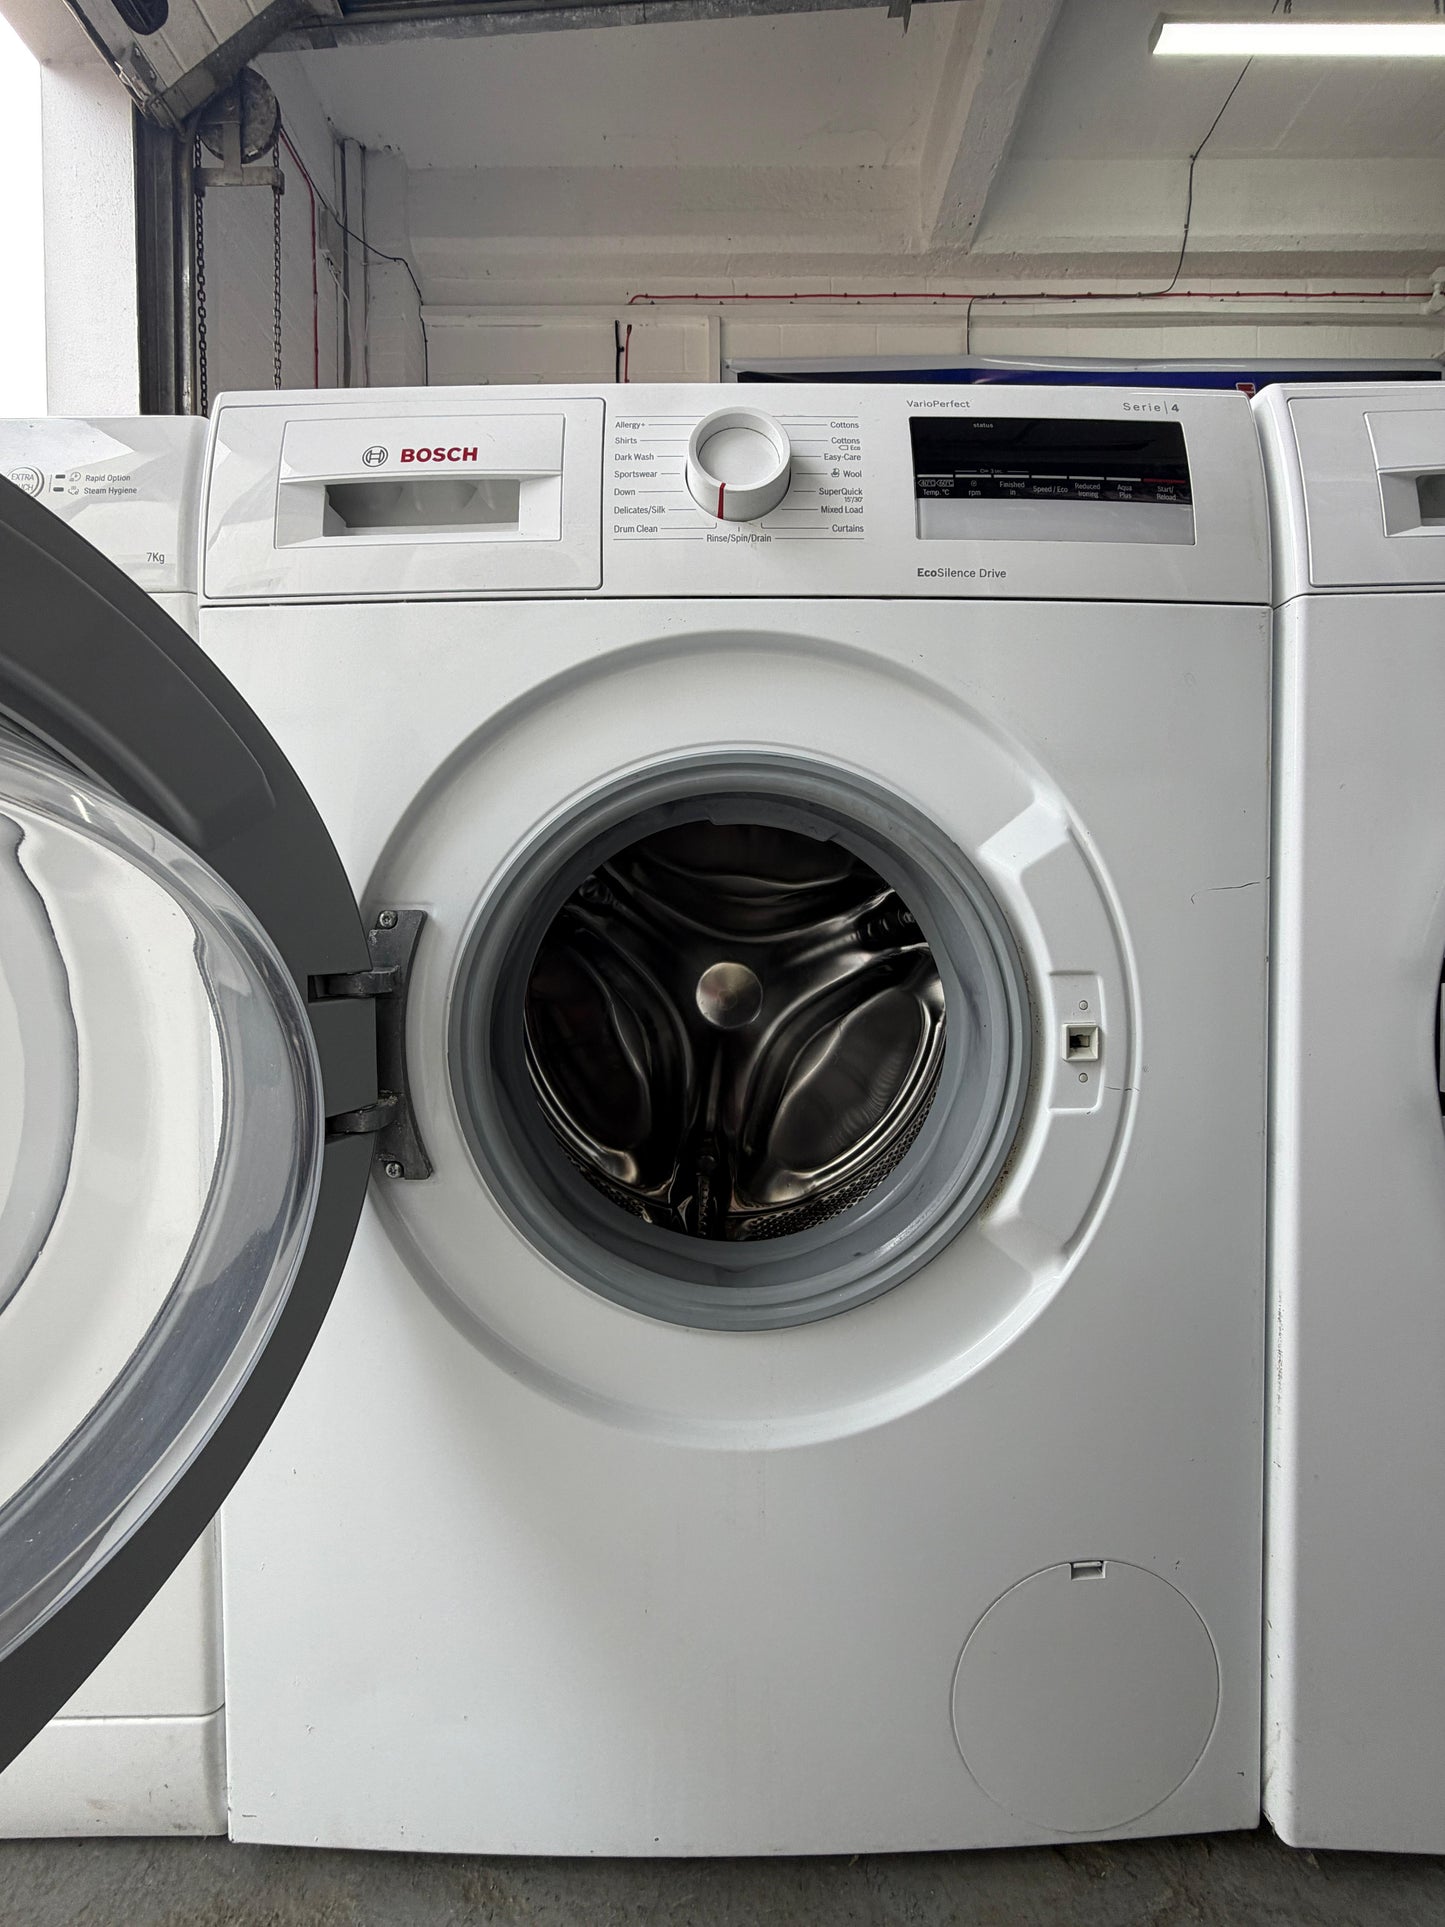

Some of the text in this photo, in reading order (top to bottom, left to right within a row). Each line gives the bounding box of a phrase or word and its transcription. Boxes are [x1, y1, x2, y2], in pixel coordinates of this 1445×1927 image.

[906, 400, 970, 408] VarioPerfect
[1122, 402, 1161, 412] Serie
[1171, 403, 1180, 413] 4
[615, 421, 645, 430] Allergy+
[830, 421, 859, 429] Cottons
[614, 436, 638, 444] Shirts
[831, 437, 860, 445] Cottons
[400, 446, 479, 463] BOSCH
[614, 453, 655, 461] Dark Wash
[823, 453, 862, 462] Easy-Care
[11, 473, 35, 481] EXTRA
[614, 470, 658, 480] Sportswear
[842, 470, 862, 478] Wool
[85, 474, 131, 484] Rapid Option
[83, 486, 138, 496] Steam Hygiene
[613, 488, 636, 496] Down
[818, 487, 863, 496] SuperQuick
[1032, 485, 1052, 493] Speed
[1117, 484, 1133, 492] Aqua
[968, 489, 982, 497] rpm
[1077, 491, 1099, 499] Ironing
[613, 505, 666, 515] Delicates/Silk
[820, 505, 864, 514] Mixed Load
[613, 524, 658, 533] Drum Clean
[831, 523, 864, 533] Curtains
[706, 533, 772, 544] Rinse/Spin/Drain
[146, 552, 165, 565] 7Kg
[917, 567, 1007, 578] EcoSilence Drive
